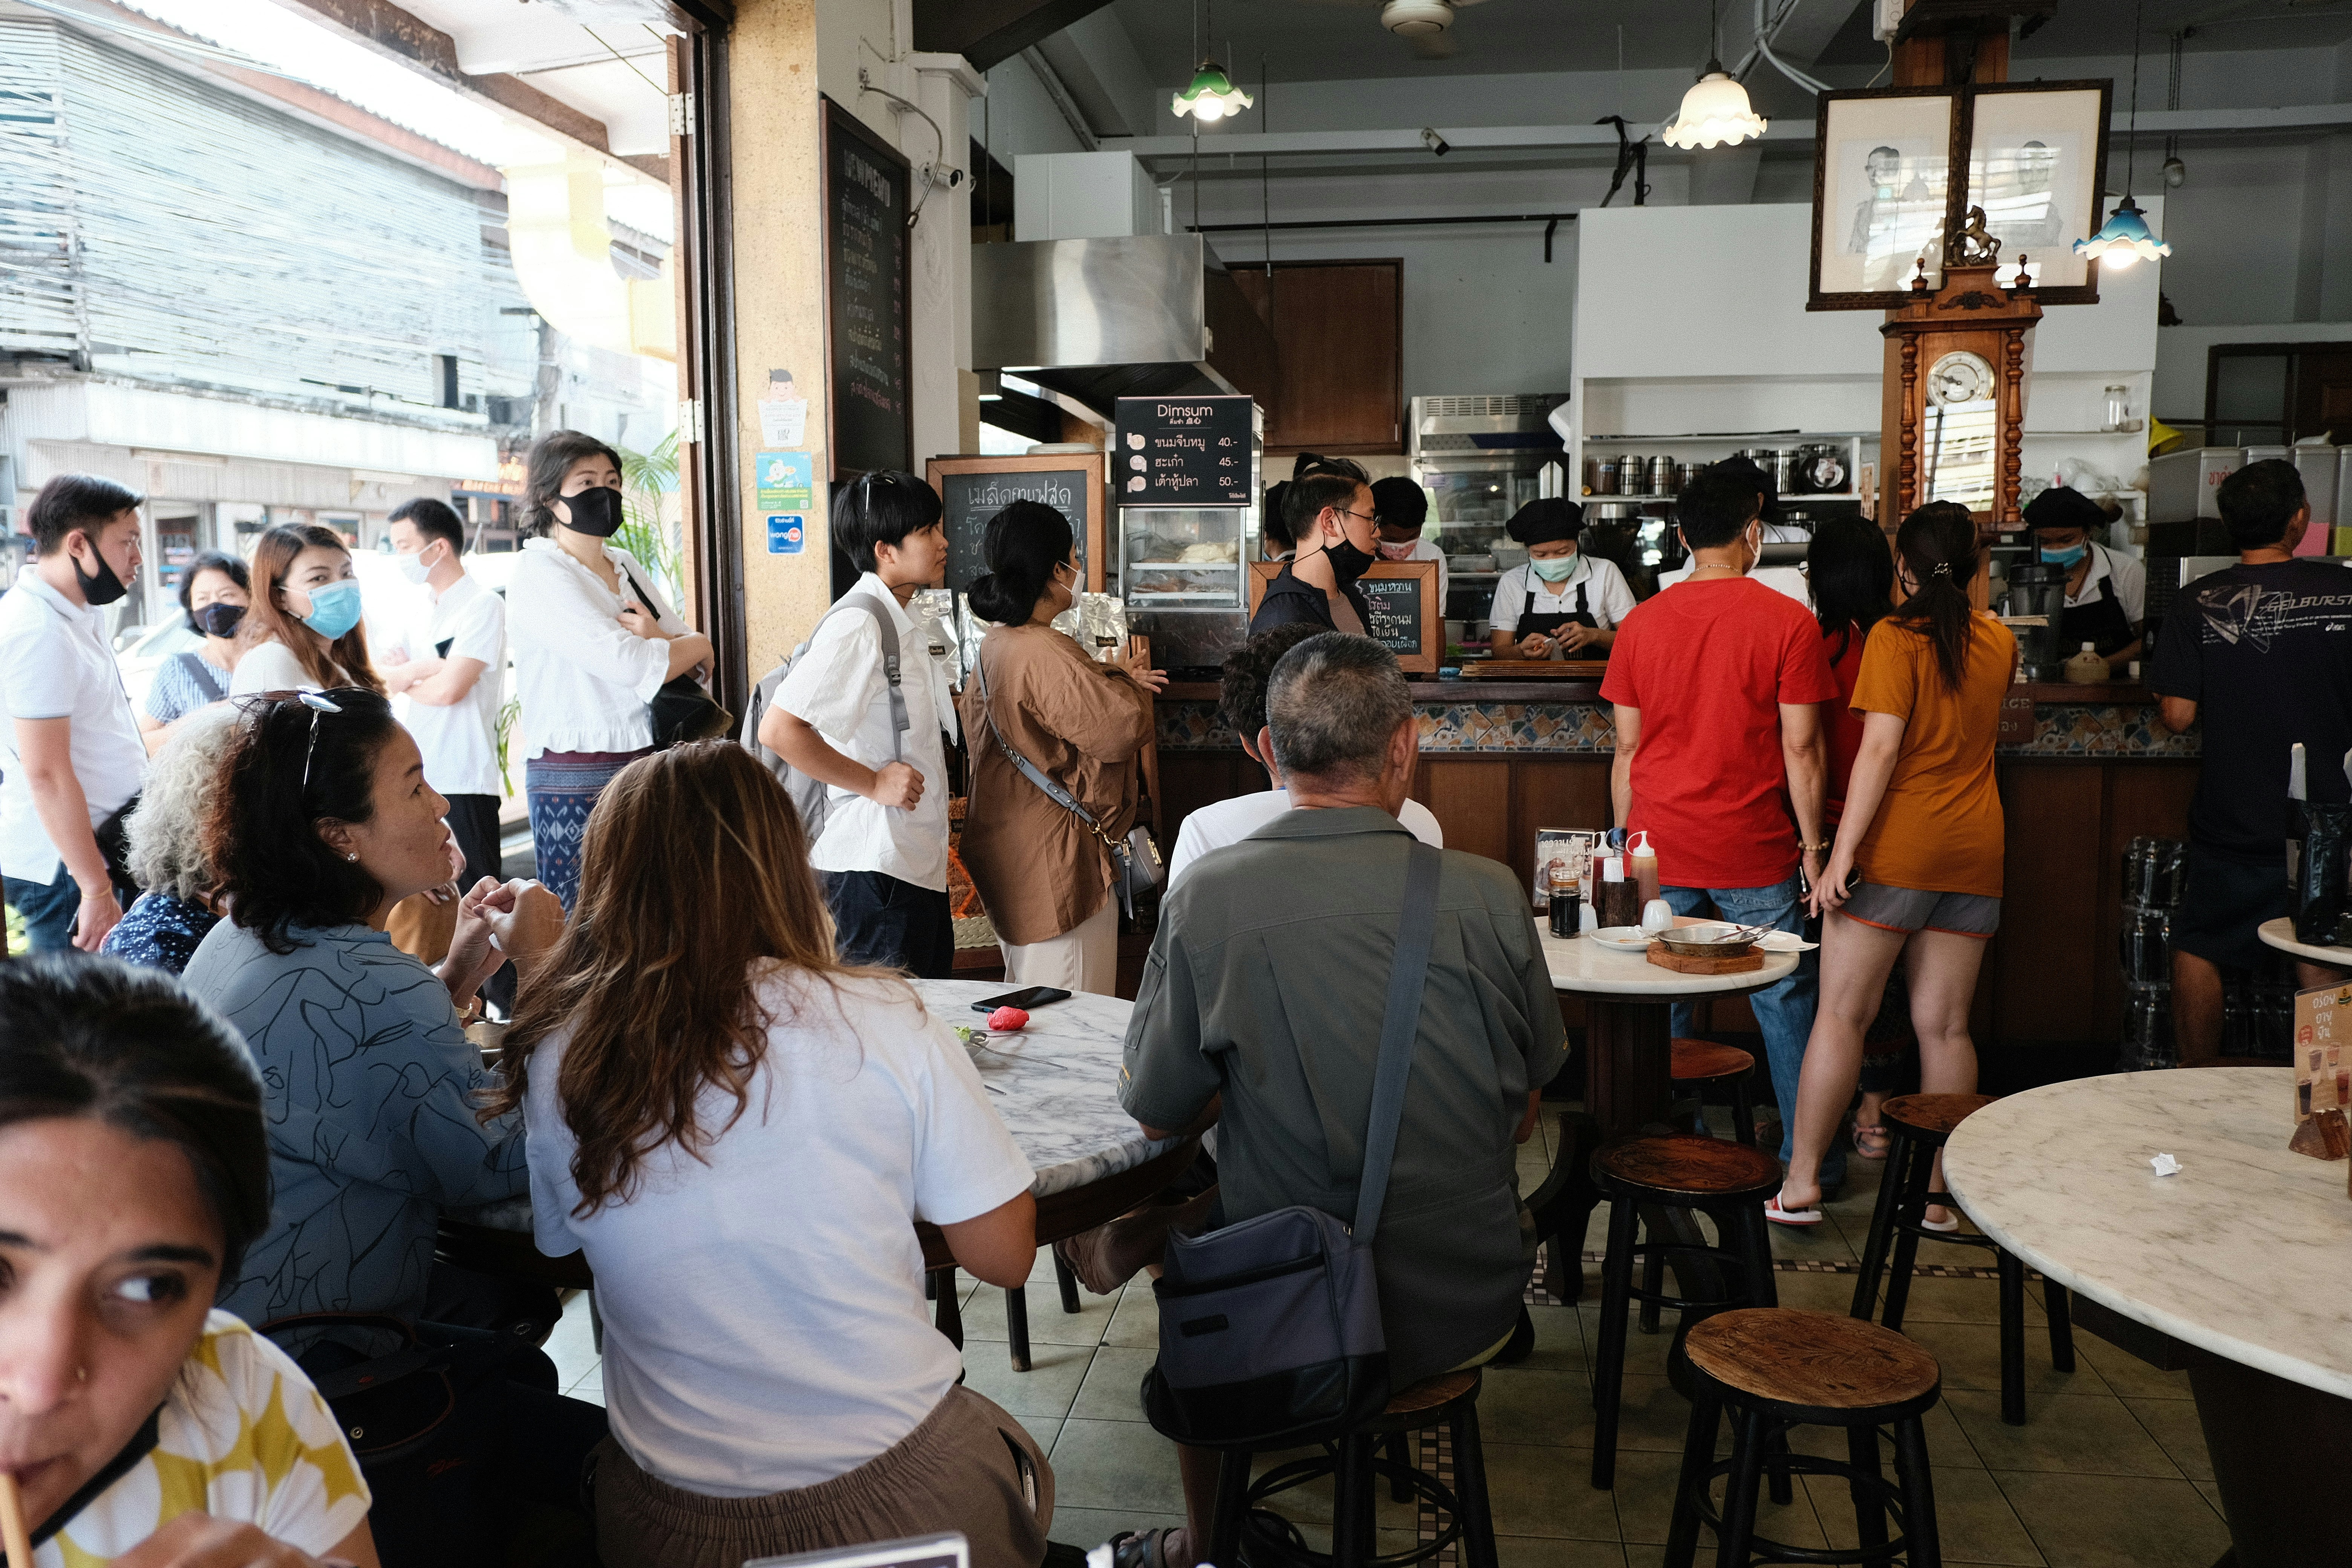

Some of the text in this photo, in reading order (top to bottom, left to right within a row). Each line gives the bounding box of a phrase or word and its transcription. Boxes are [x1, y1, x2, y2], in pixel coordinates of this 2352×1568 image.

[1158, 404, 1213, 416] Dimsum
[1155, 434, 1238, 452] ขนมจีบหมู 40.-
[1155, 453, 1238, 467] ฮะเก๋า 45.-
[1155, 473, 1238, 491] เต้าหู้ปลา 50.-
[1369, 582, 1412, 593] ขนมหวาน
